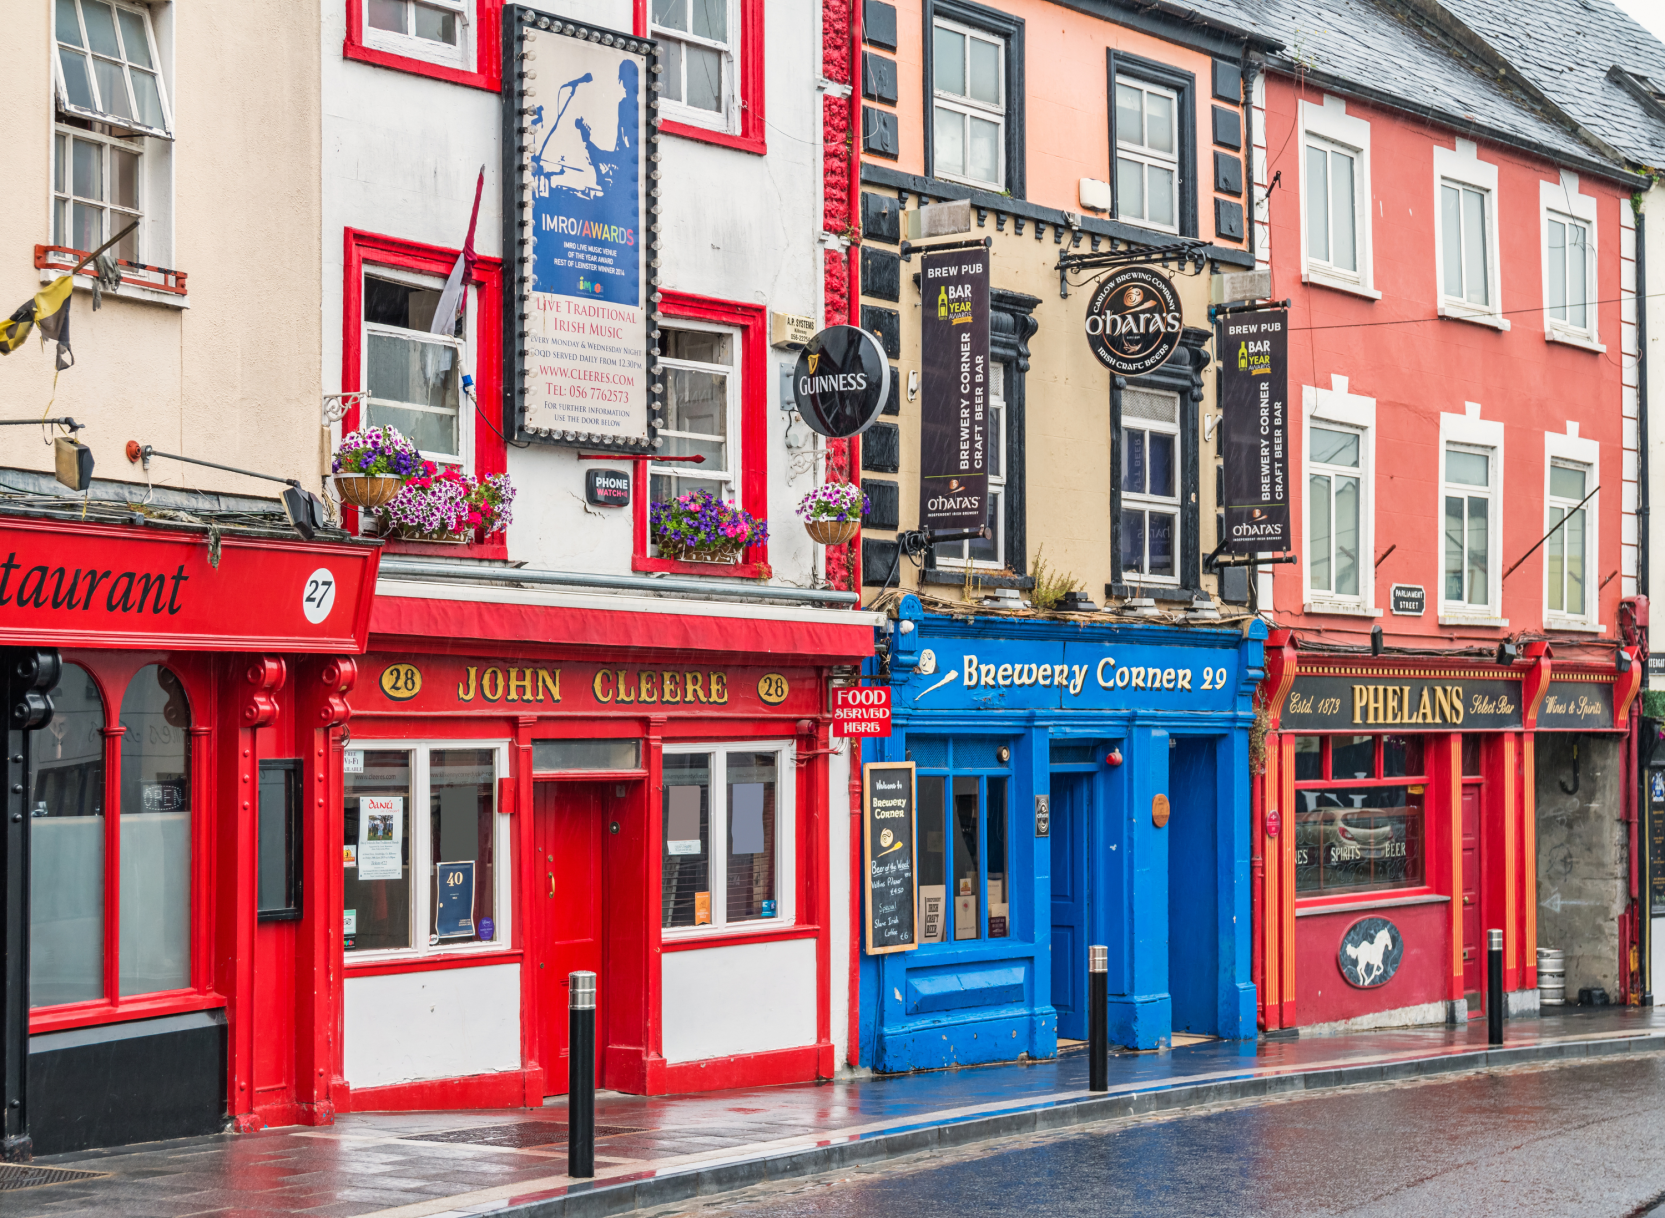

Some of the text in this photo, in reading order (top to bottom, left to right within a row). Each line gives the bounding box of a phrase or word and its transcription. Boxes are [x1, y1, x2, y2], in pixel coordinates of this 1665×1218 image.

[542, 213, 634, 246] IMRO/AWARDS
[564, 241, 617, 257] IMRO LIVE MUSIC VENUE
[575, 261, 597, 271] LEINSTER
[598, 266, 615, 274] WINNER
[585, 254, 597, 262] YEAR
[598, 256, 613, 265] AWARD
[927, 263, 983, 278] BREW PUB
[948, 284, 972, 299] BAR
[1093, 271, 1175, 313] CARLOW BREWING COMPANY
[949, 301, 971, 313] YEAR
[796, 319, 815, 330] SYSTEMS
[1229, 322, 1281, 335] BREW PUB
[1248, 340, 1270, 353] BAR
[552, 350, 577, 361] SERVED
[579, 354, 598, 364] DAILY
[599, 357, 617, 367] FROM
[960, 332, 971, 394] CORNER
[1097, 343, 1169, 371] IRISH CRAFT BEERS
[1249, 355, 1270, 365] YEAR
[539, 365, 635, 387] WWW.CLEERES.COM
[569, 385, 587, 399] 056
[590, 387, 629, 403] 7762573
[974, 354, 984, 469] CRAFT BEER BAR
[1260, 381, 1270, 435] CORNER
[567, 415, 579, 423] THE
[581, 417, 599, 426] DOOR
[601, 418, 620, 427] BELOW
[960, 398, 970, 470] BREWERY
[1274, 401, 1284, 500] CRAFT BEER BAR
[1260, 439, 1271, 501] BREWERY
[595, 477, 628, 489] PHONE
[596, 488, 622, 497] WATCH
[0, 552, 189, 615] taurant
[305, 579, 332, 609] 27
[1395, 589, 1423, 599] PARLIAMENT
[1400, 601, 1419, 609] STREET
[390, 667, 416, 691] 28
[458, 666, 728, 705] JOHN CLEERE
[764, 676, 784, 698] 28
[1200, 667, 1227, 690] 29
[837, 690, 886, 705] FOOD
[1352, 684, 1464, 725] PHELANS
[1469, 694, 1515, 714] Select Bar
[834, 708, 890, 719] SERVED
[1317, 698, 1341, 716] 1873
[1545, 695, 1602, 720] Wines & Spirits
[844, 722, 880, 734] HERE
[1330, 845, 1361, 862] SPIRITS
[1385, 842, 1406, 857] BEER
[446, 871, 463, 887] 40
